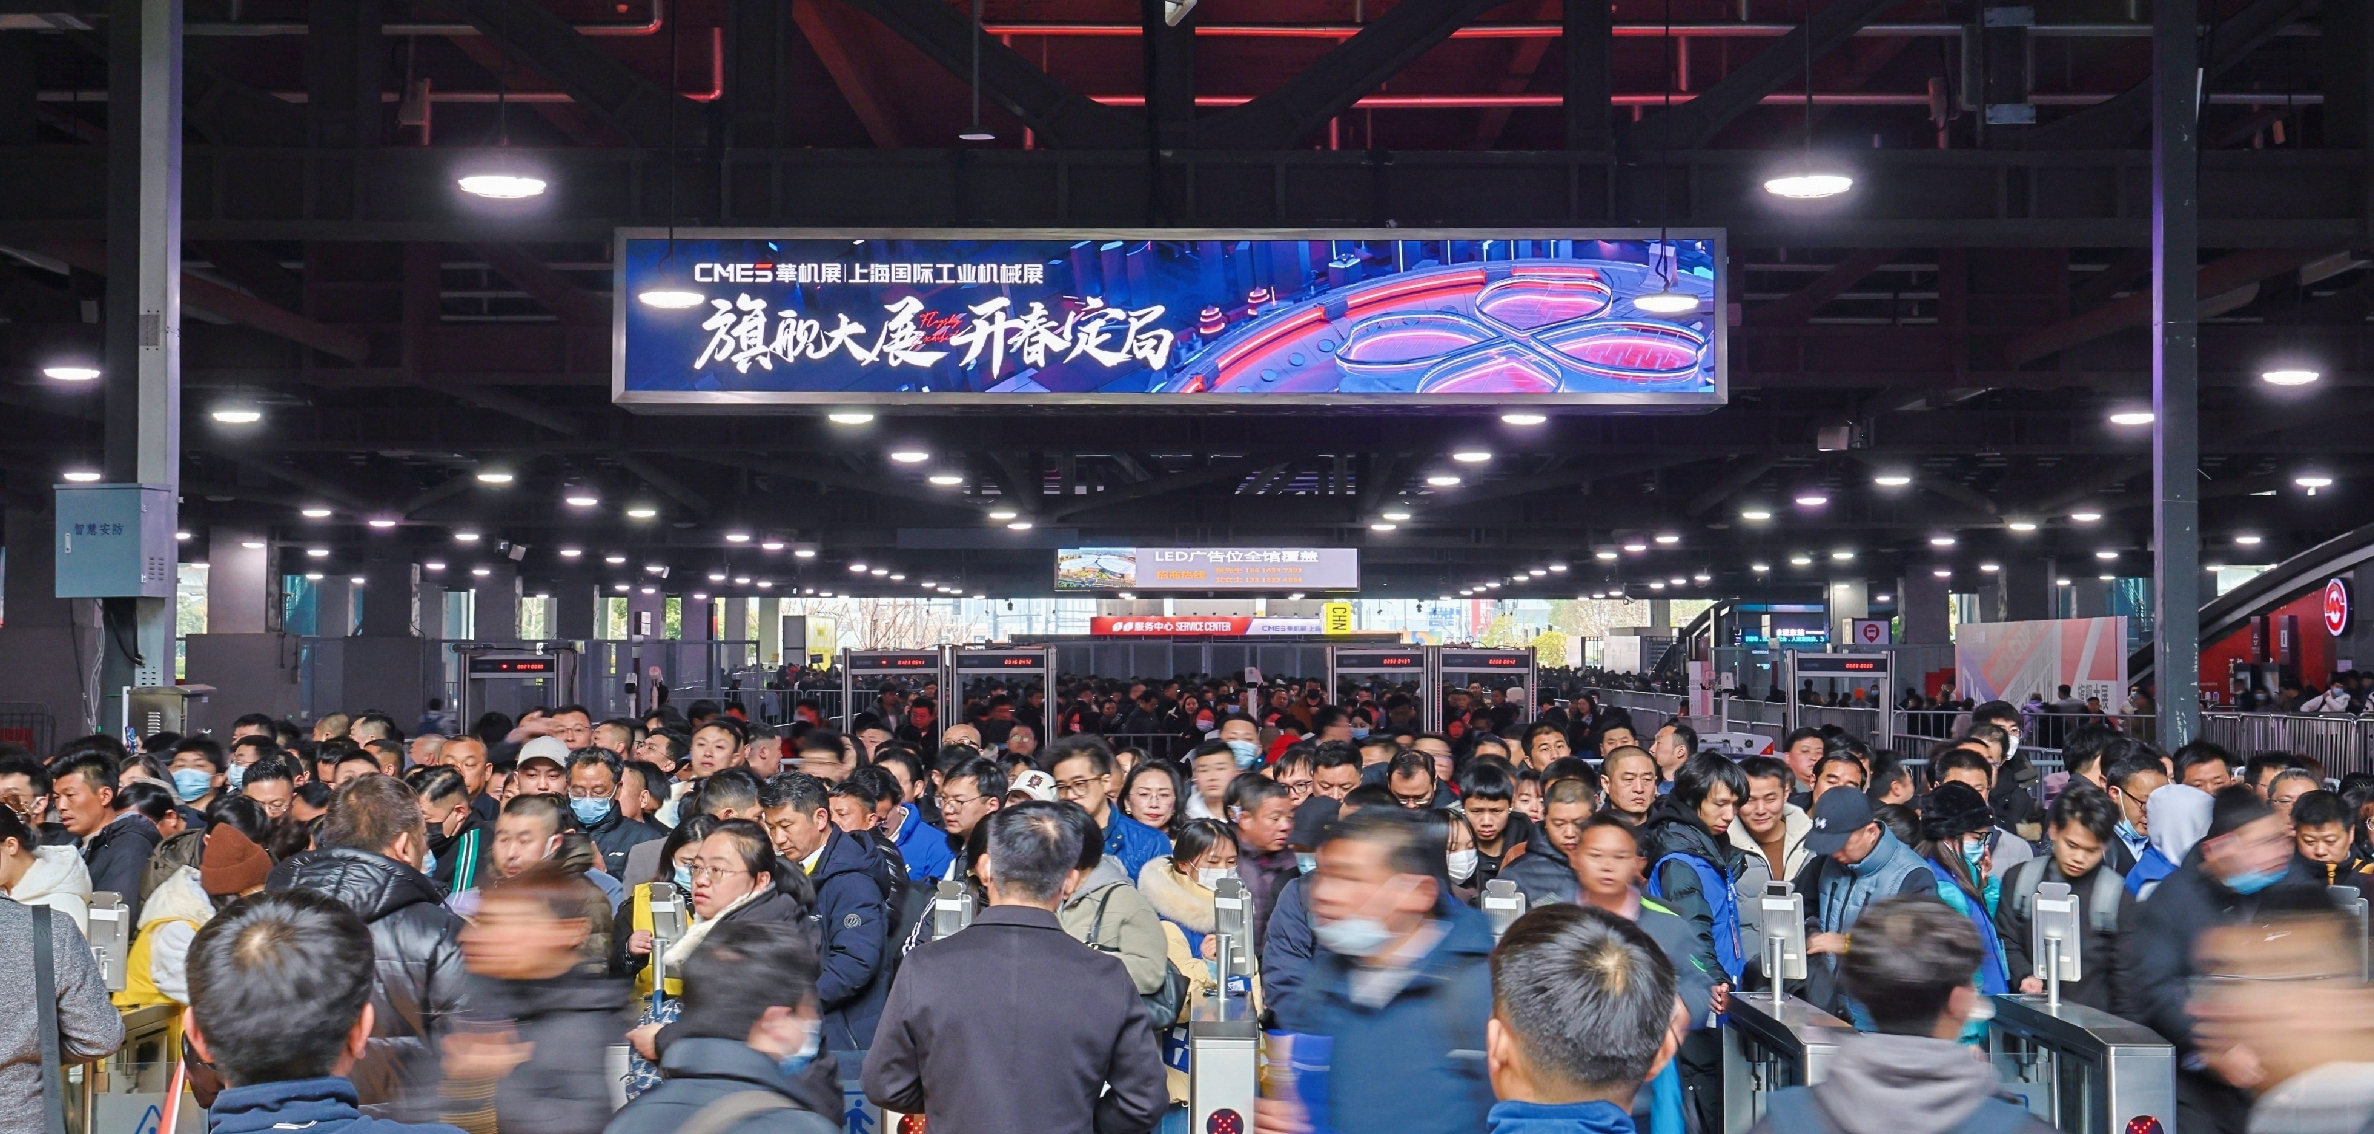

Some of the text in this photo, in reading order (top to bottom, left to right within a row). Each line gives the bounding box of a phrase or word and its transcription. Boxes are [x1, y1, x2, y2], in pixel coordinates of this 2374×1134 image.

[695, 263, 773, 282] CMES
[848, 263, 1044, 284] 上海国际工业机械展
[694, 292, 1175, 380] 旗舰大展 开春定局
[74, 523, 124, 536] 智慧安防
[1134, 621, 1231, 632] 服务中心 SERVICE CENTER
[1332, 607, 1347, 631] CHN
